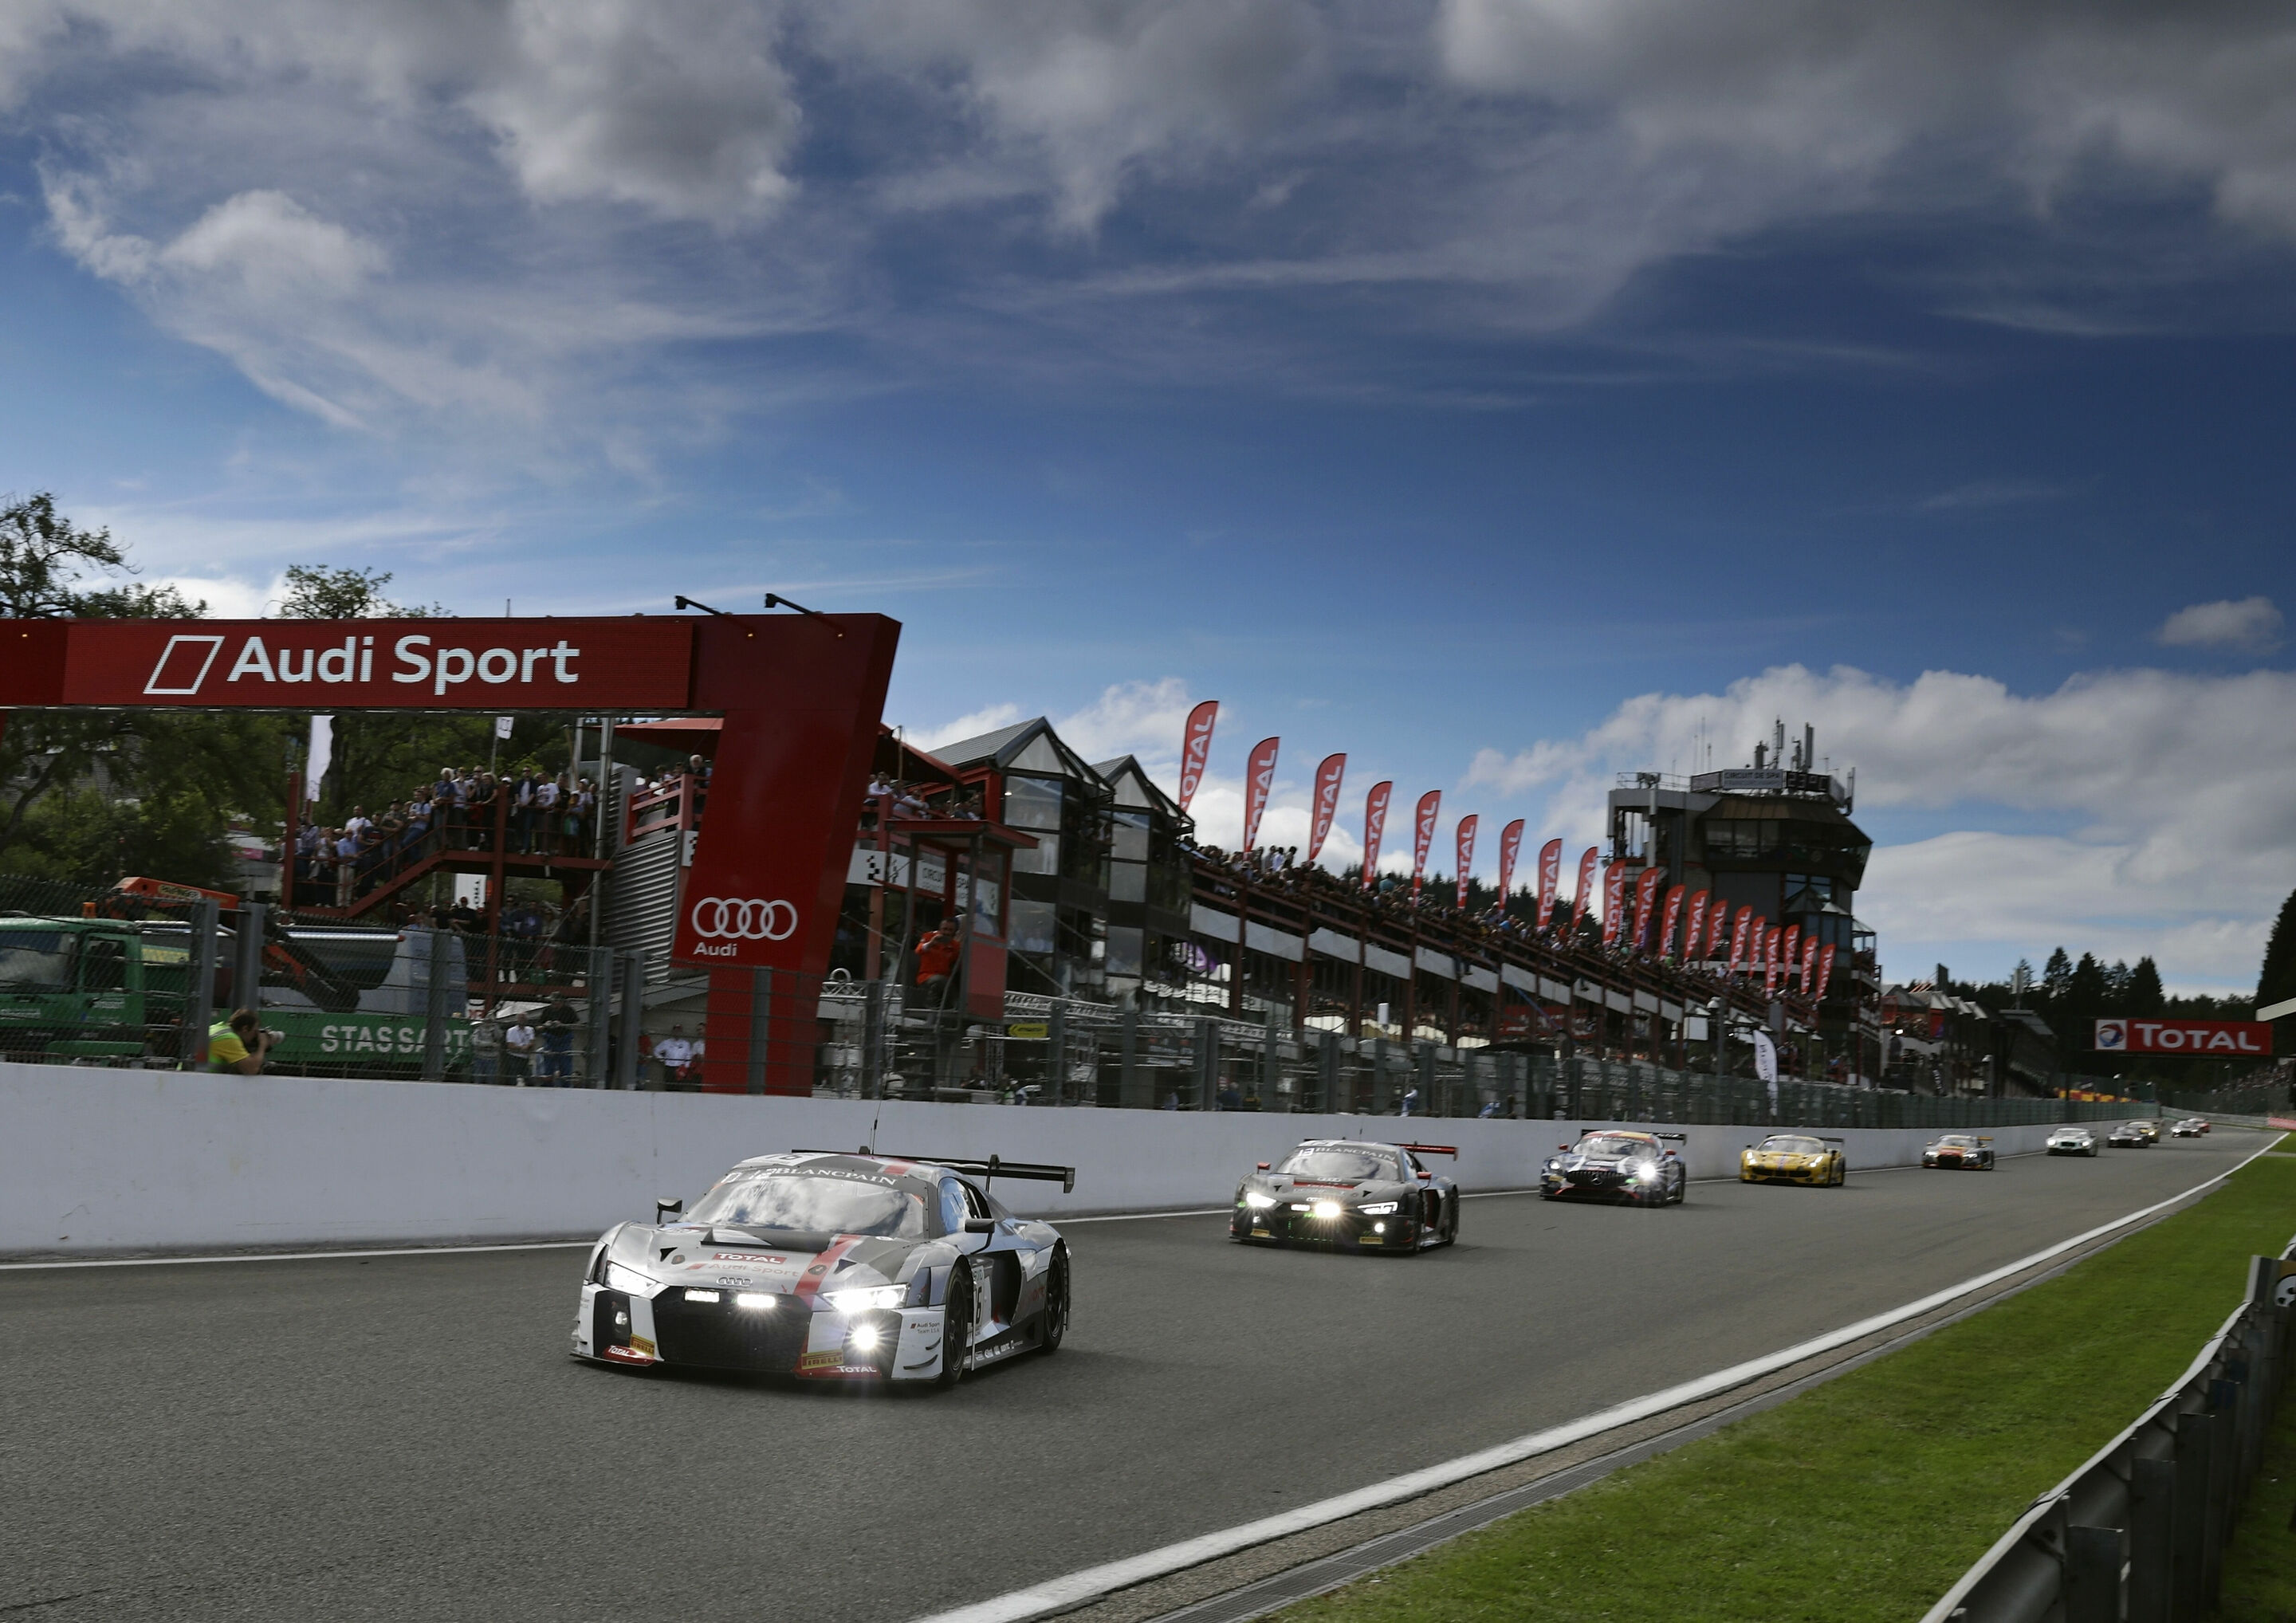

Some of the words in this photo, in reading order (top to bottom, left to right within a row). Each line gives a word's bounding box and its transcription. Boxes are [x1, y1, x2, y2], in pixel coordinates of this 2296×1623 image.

[226, 635, 374, 682] Audi
[391, 635, 580, 696] Sport
[1181, 714, 1213, 808] OTAL
[1246, 749, 1276, 847] TOTAL
[1457, 824, 1475, 902] TOTAL
[1539, 847, 1559, 922] TOTAL
[1604, 868, 1623, 937] TOTAL
[1687, 896, 1706, 951] TOTAL
[1731, 911, 1751, 965] TOTAL
[693, 941, 737, 957] Audi
[2133, 1024, 2262, 1051] TOTAL
[1315, 1148, 1396, 1161] BLANCPAIN
[775, 1168, 897, 1186] BLANCPAIN
[717, 1253, 782, 1264] TOTAL
[752, 1266, 801, 1278] Sport
[607, 1345, 630, 1356] TOTAL
[802, 1351, 843, 1366] PIRELLI
